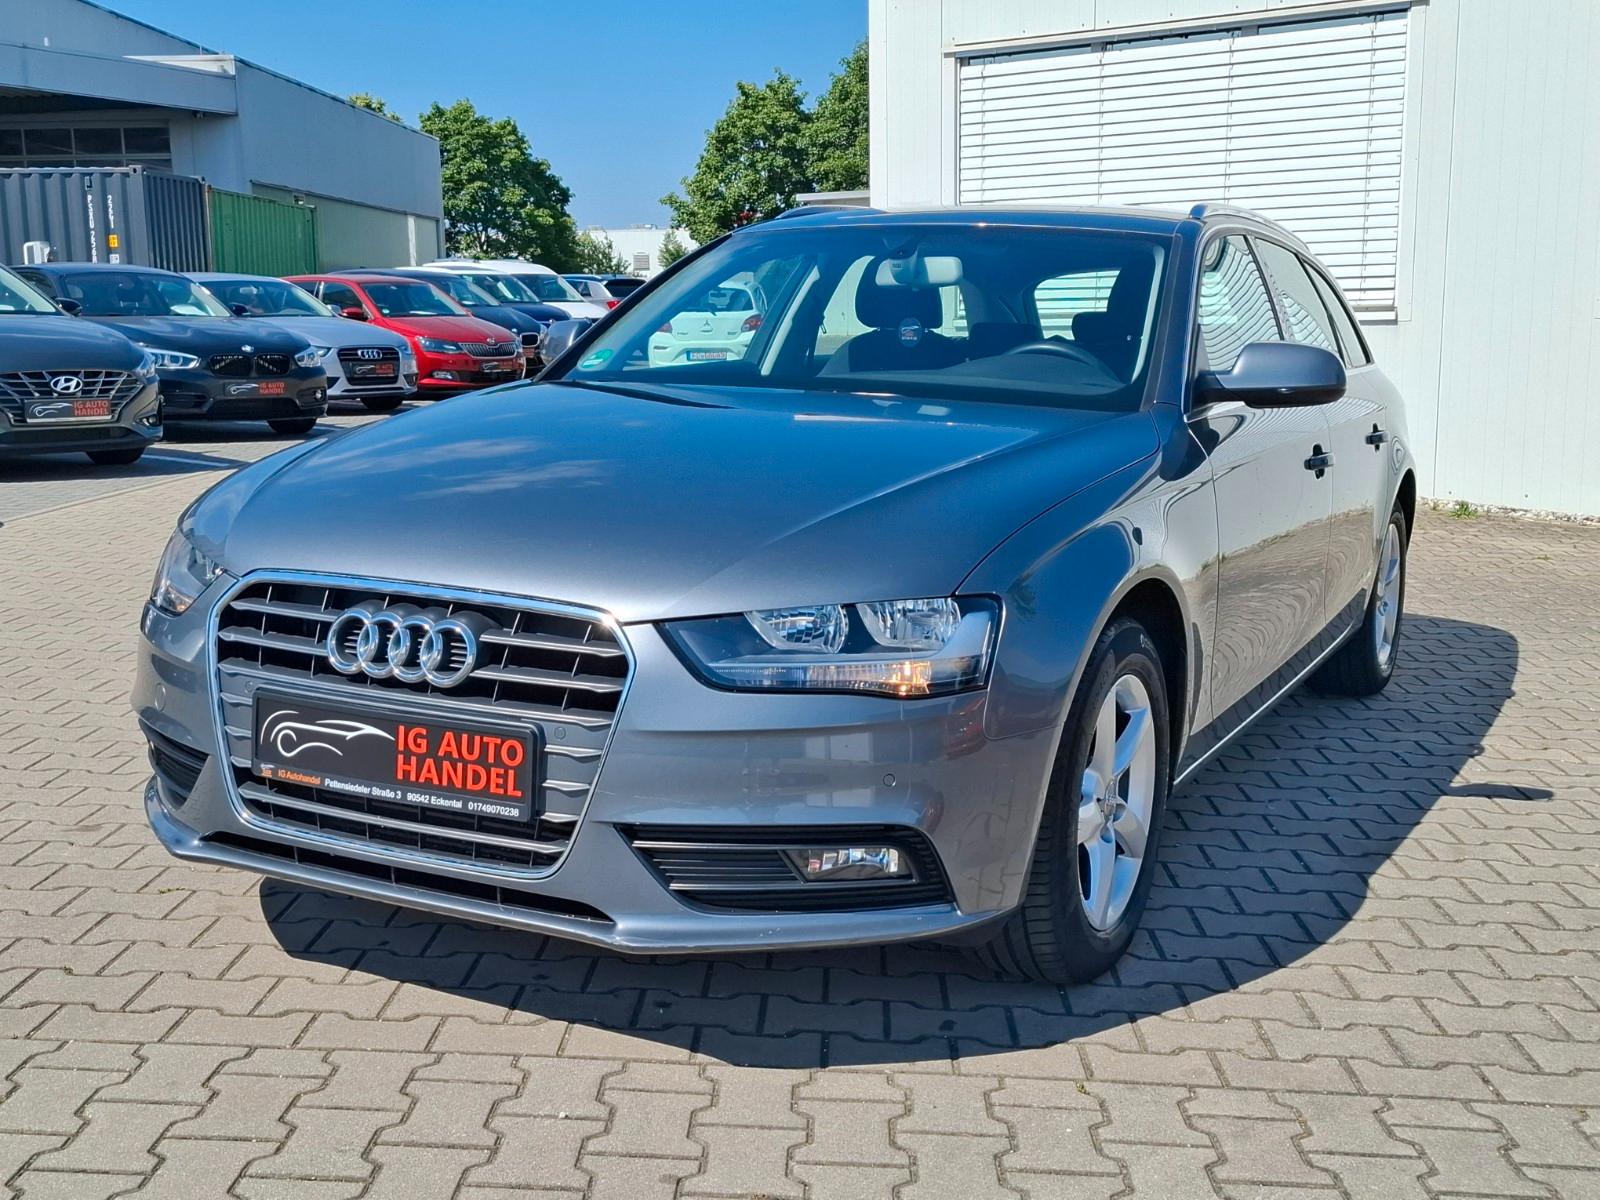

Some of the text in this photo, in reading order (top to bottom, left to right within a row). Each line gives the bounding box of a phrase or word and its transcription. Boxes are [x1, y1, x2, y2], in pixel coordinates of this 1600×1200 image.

[74, 400, 108, 408] IG AUTO
[74, 408, 109, 416] HANDEL
[397, 724, 524, 767] IG AUTO
[278, 769, 286, 778] IG
[286, 771, 321, 785] Autohandel
[371, 786, 395, 798] Straße
[396, 791, 402, 799] 3
[406, 792, 430, 803] 90542
[430, 796, 463, 809] Eckental
[468, 802, 519, 817] 01749070238
[396, 753, 523, 797] HANDEL
